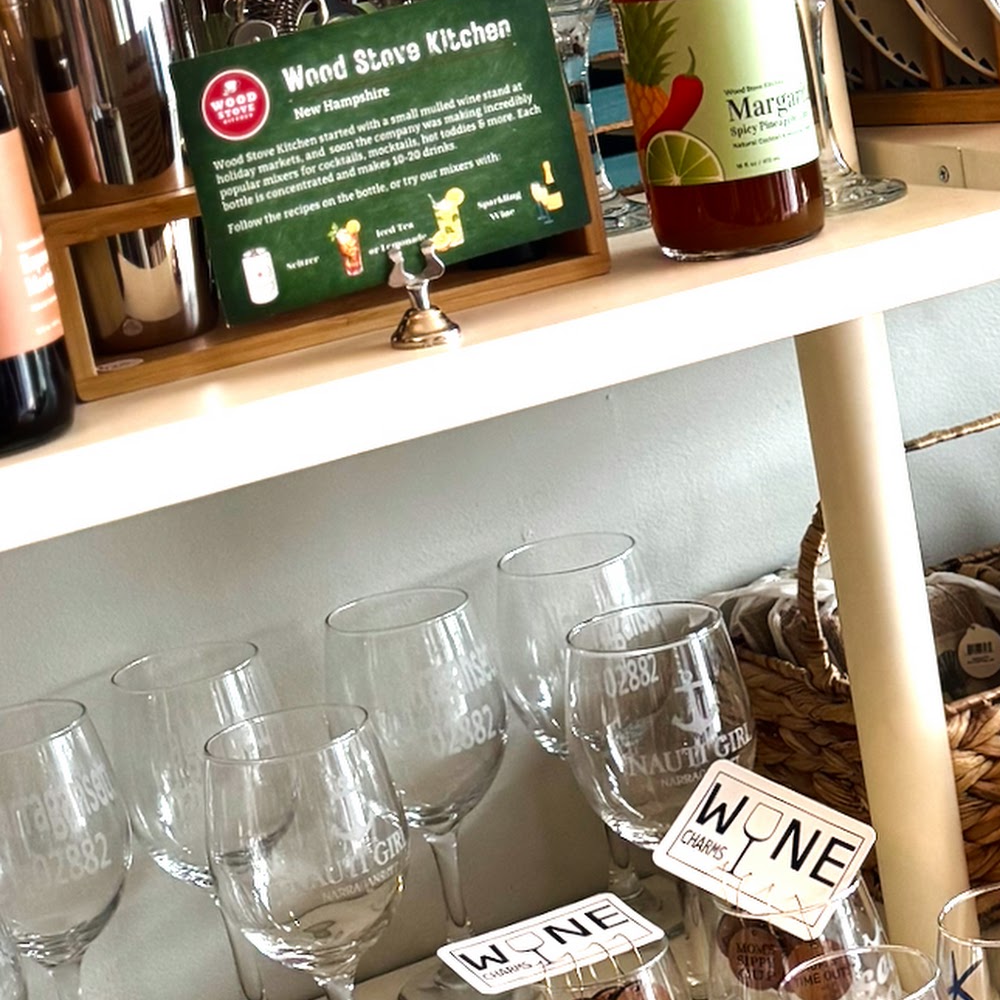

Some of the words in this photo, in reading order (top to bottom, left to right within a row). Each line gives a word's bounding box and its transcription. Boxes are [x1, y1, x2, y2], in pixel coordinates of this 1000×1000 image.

[281, 54, 349, 93] Wood
[353, 42, 422, 75] Stove
[425, 18, 512, 55] Kitchen
[210, 91, 258, 112] WOOD
[212, 154, 245, 171] Wood
[246, 148, 276, 163] Stove
[276, 137, 318, 155] Kitchen
[318, 124, 357, 144] started
[356, 119, 382, 133] with
[382, 118, 390, 127] a
[390, 108, 420, 125] small
[420, 98, 457, 117] mulled
[456, 94, 482, 107] wine
[482, 84, 512, 101] stand
[512, 82, 524, 93] at
[217, 103, 256, 120] STOVE
[293, 104, 322, 121] New
[323, 87, 391, 113] Hampshire
[216, 167, 256, 185] holiday
[305, 146, 326, 161] and
[329, 141, 355, 155] soon
[355, 136, 373, 148] the
[374, 123, 421, 143] company
[422, 118, 443, 130] was
[444, 107, 484, 125] making
[483, 93, 533, 114] incredibly
[219, 180, 261, 200] popular
[263, 170, 300, 187] mixers
[300, 165, 317, 176] for
[318, 152, 367, 172] cocktails,
[421, 132, 439, 145] hot
[440, 123, 477, 139] toddies
[517, 104, 543, 120] Each
[730, 124, 756, 138] Spicy
[221, 195, 254, 212] bottle
[255, 193, 265, 204] is
[266, 172, 335, 200] concentrated
[336, 166, 357, 181] and
[357, 160, 391, 175] makes
[392, 150, 422, 166] 10-20
[227, 217, 264, 235] Follow
[263, 212, 282, 225] the
[283, 201, 322, 220] recipes
[322, 197, 337, 209] on
[337, 192, 355, 204] the
[389, 180, 402, 190] or
[402, 175, 419, 187] try
[419, 169, 438, 182] our
[439, 160, 475, 177] mixers
[603, 653, 660, 697] 02882
[627, 744, 709, 778] NAUTI
[714, 722, 753, 758] GIRL
[680, 829, 729, 861] CHARMS
[482, 960, 534, 981] CHARMS
